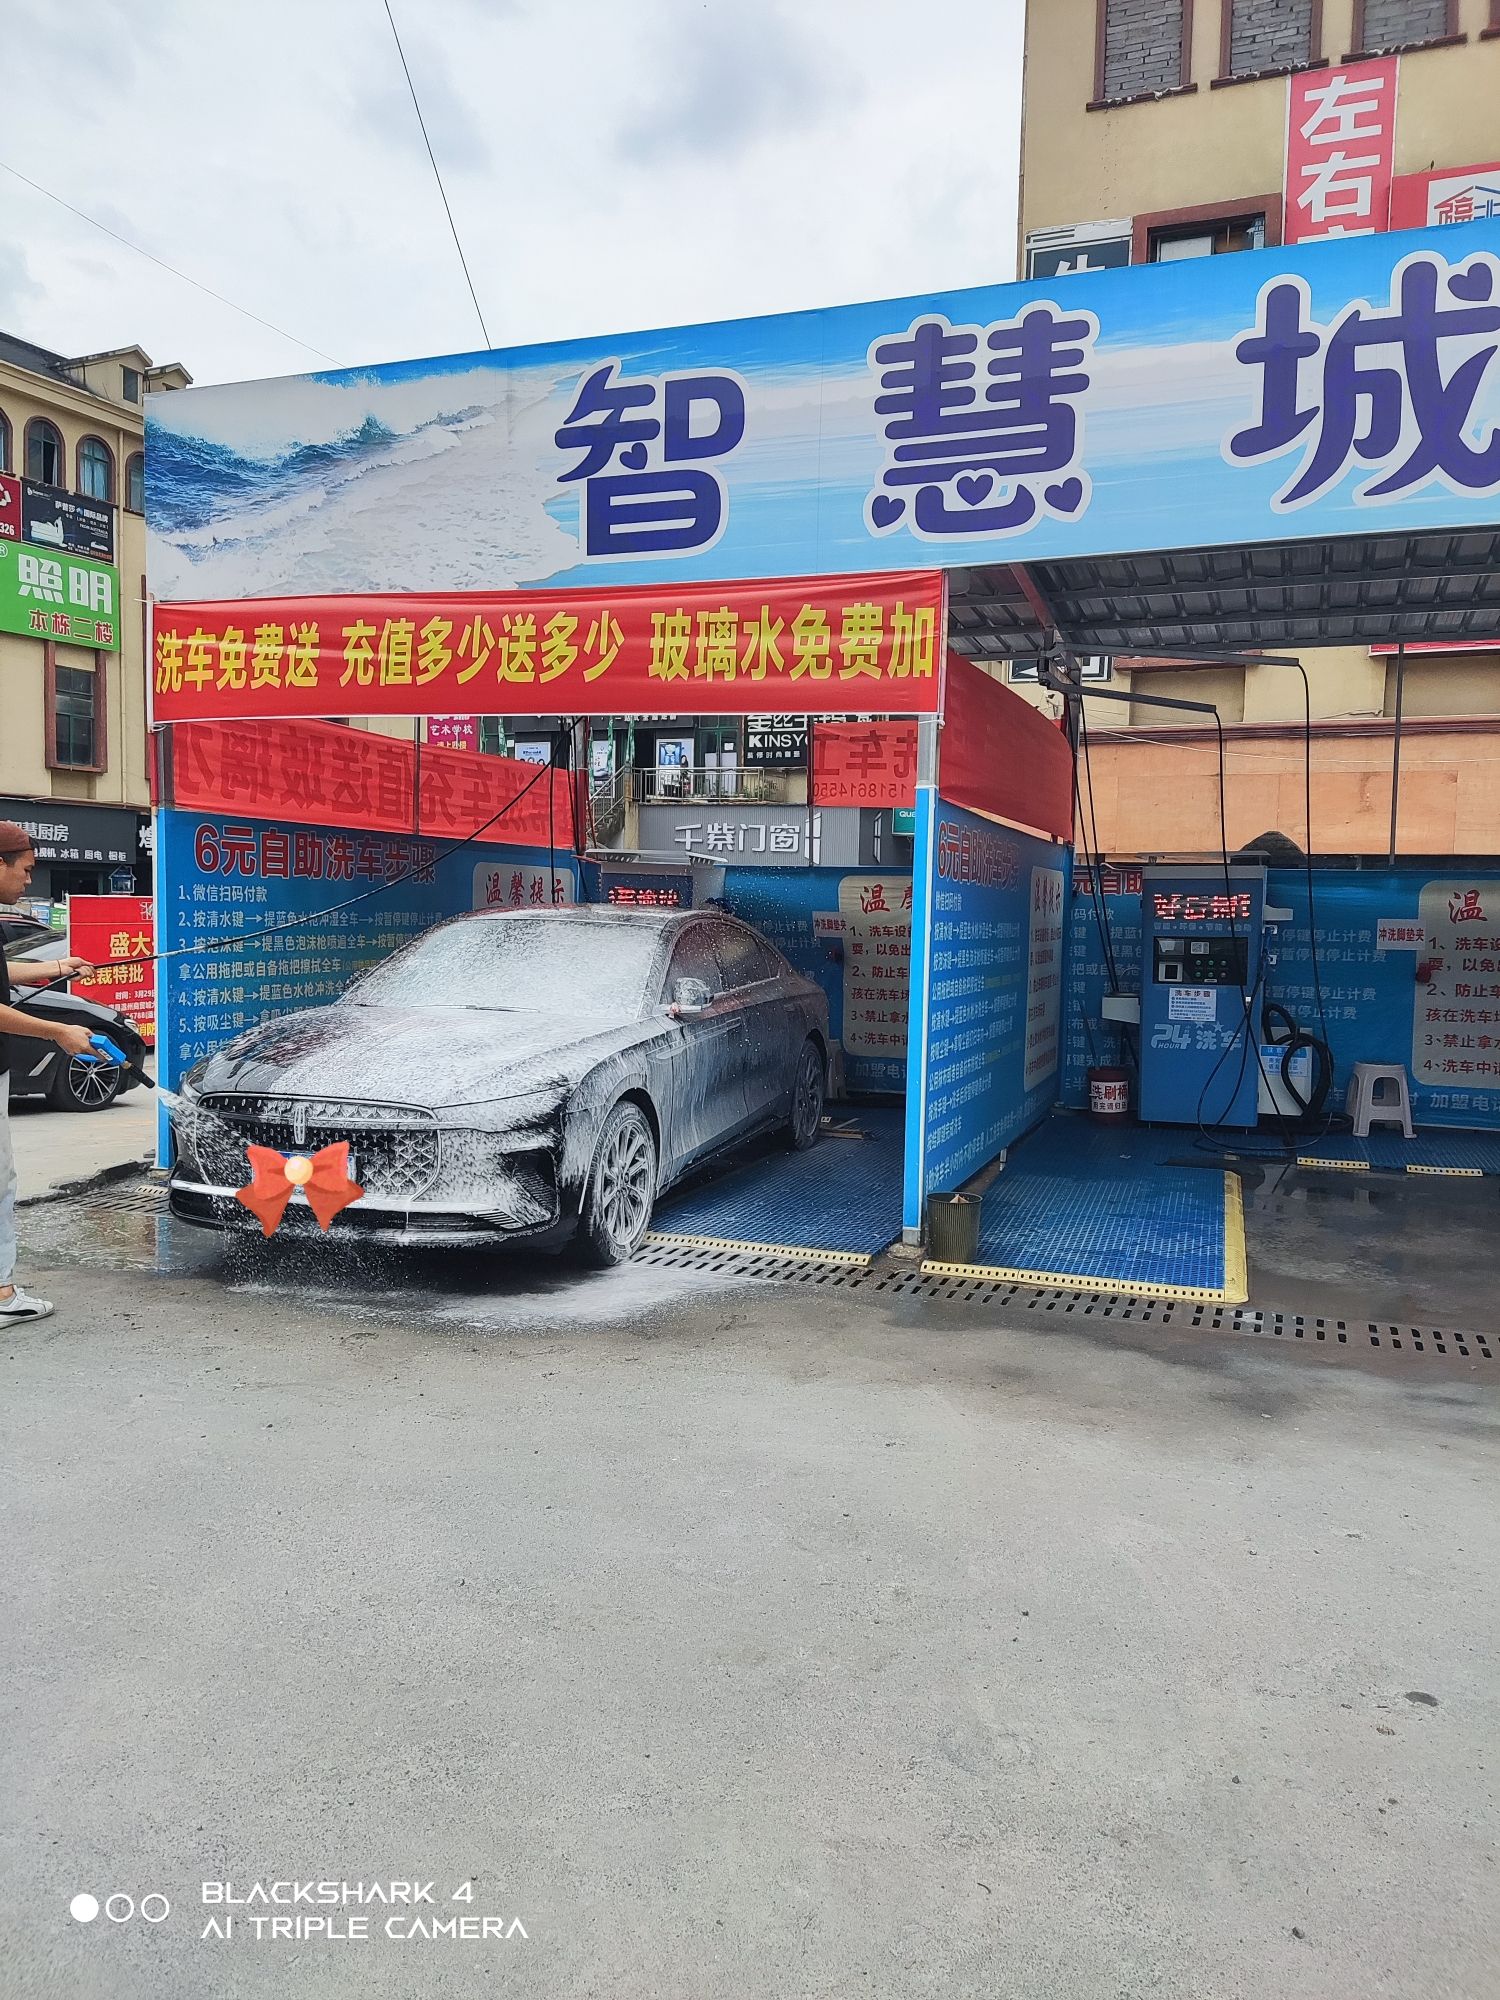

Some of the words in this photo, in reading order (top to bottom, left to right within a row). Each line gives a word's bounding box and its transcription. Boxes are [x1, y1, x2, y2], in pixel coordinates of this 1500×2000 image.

[1297, 75, 1384, 244] 左右
[18, 553, 113, 615] 照明
[29, 608, 113, 644] 本栋二楼
[155, 620, 321, 693] 洗车免费送
[340, 610, 625, 687] 充值多少送多少
[648, 601, 934, 682] 玻璃水免费加
[749, 734, 808, 748] KINSY
[674, 822, 800, 852] 千紫门窗
[60, 848, 80, 860] 冰箱
[178, 883, 268, 903] 1、微信扫码付款
[1448, 888, 1489, 925] 温
[1150, 1023, 1192, 1050] 24
[1195, 1030, 1242, 1050] 洗车
